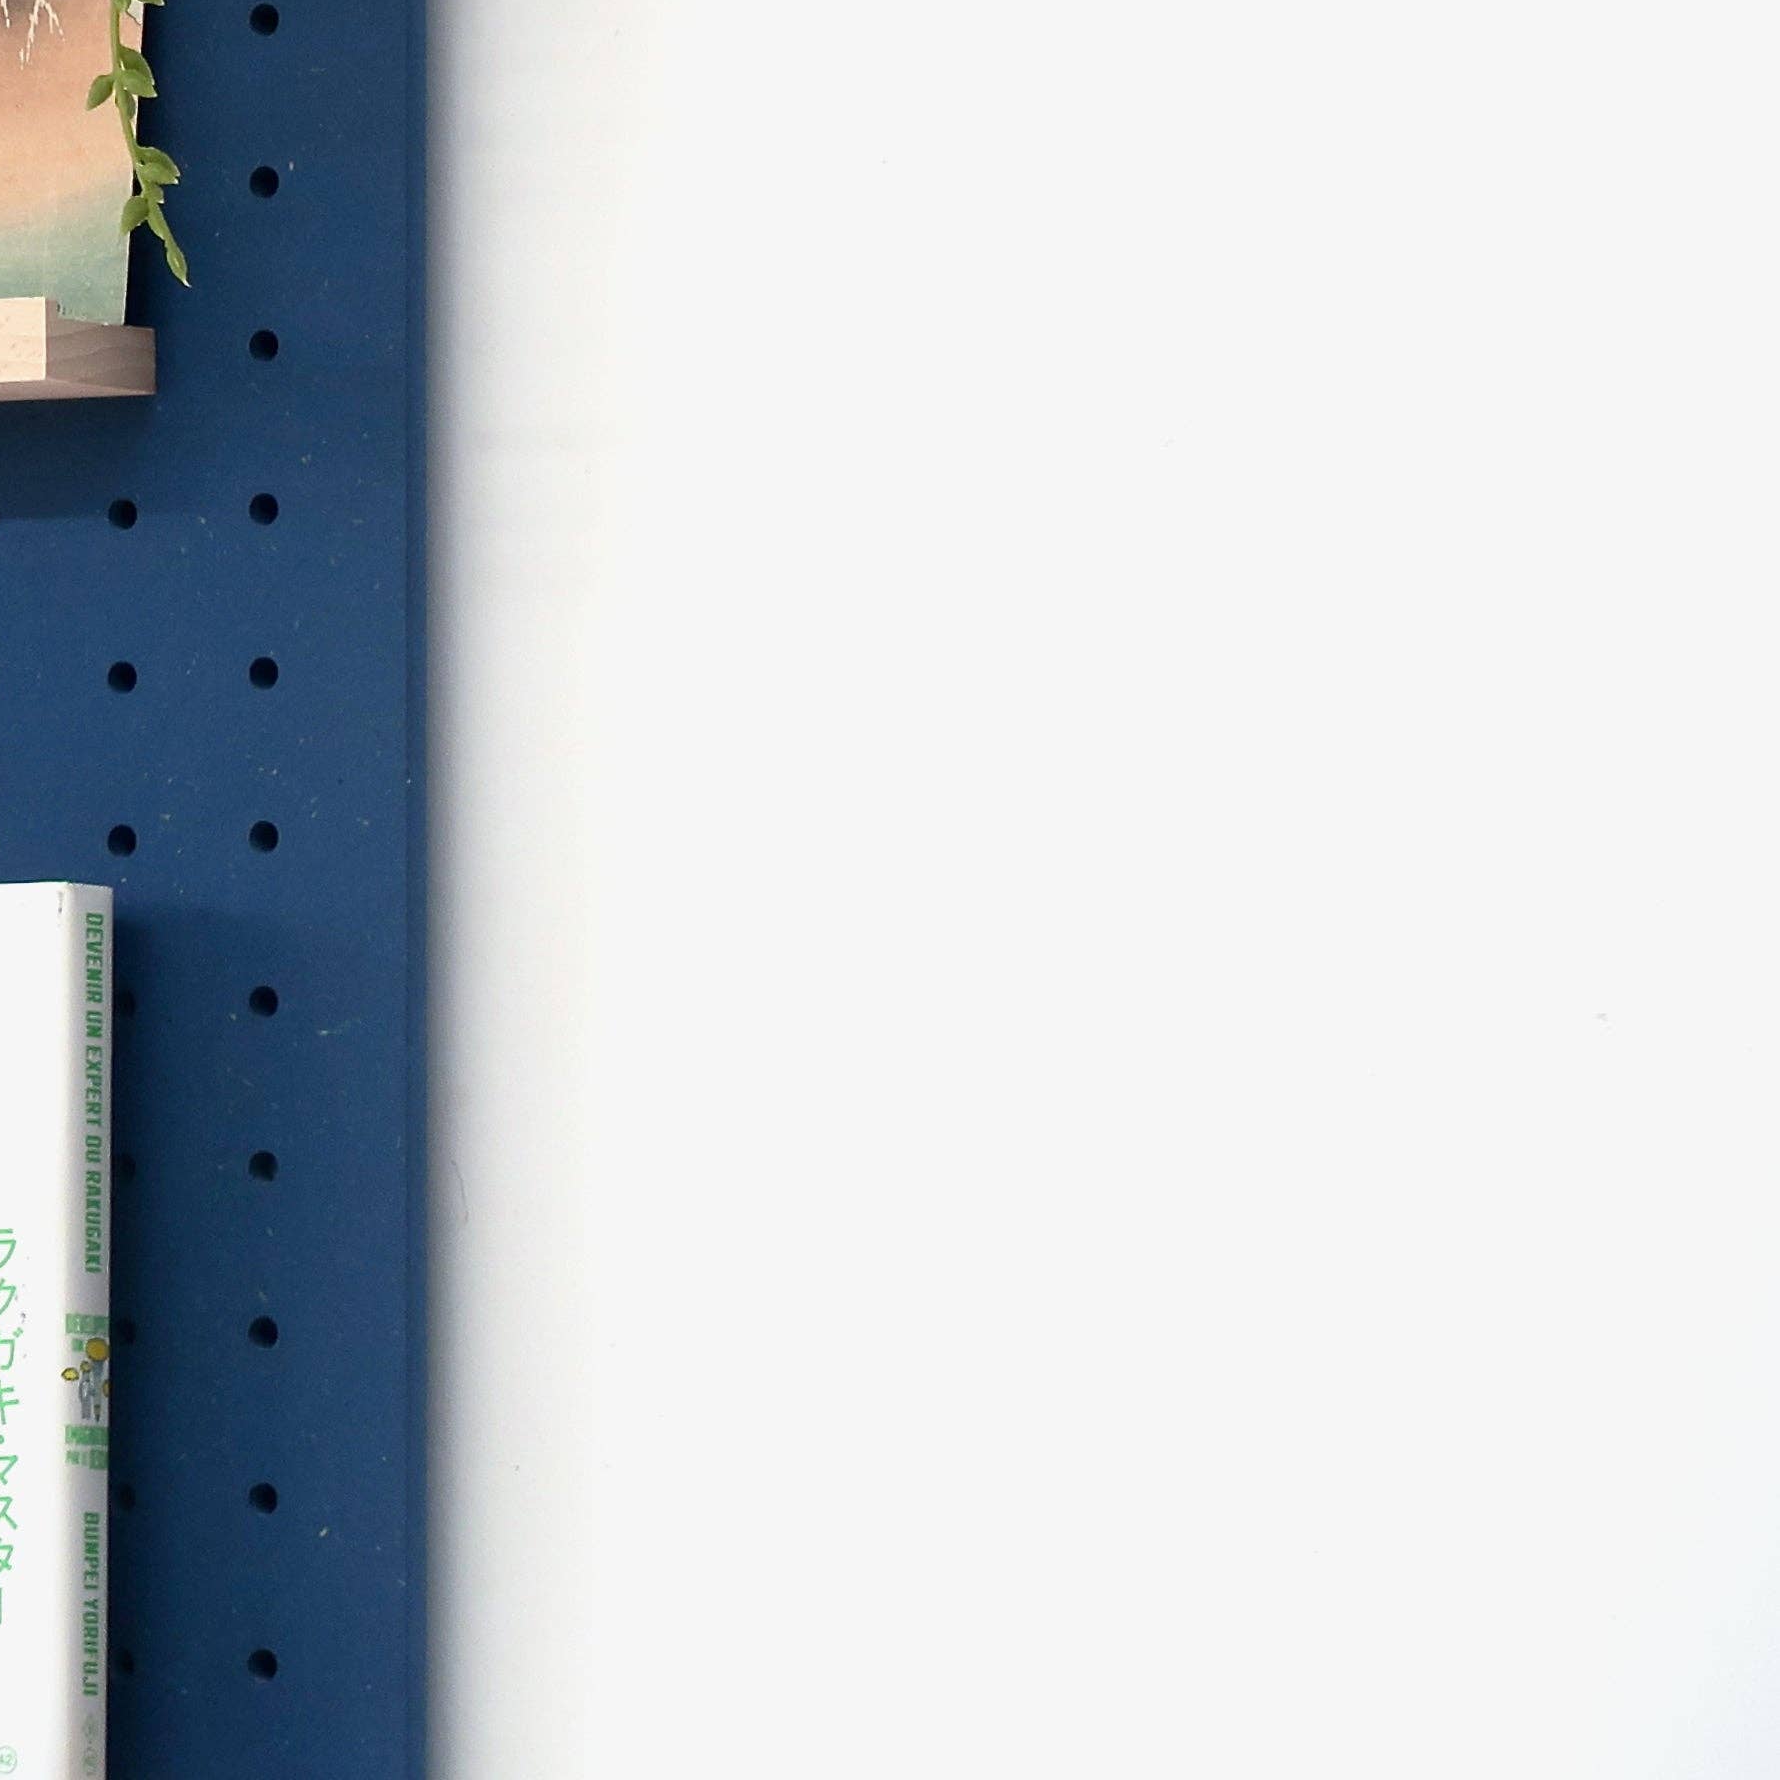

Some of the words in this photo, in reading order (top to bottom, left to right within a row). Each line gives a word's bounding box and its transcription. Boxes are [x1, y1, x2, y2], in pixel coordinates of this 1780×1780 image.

[85, 912, 104, 1004] DEVENIR
[85, 1010, 103, 1038] UN
[85, 1045, 103, 1127] EXPERT
[85, 1135, 102, 1163] DU
[85, 1170, 102, 1273] RAKUGAKI
[83, 1512, 101, 1590] BUNPEI
[82, 1598, 100, 1697] YORIFUJI
